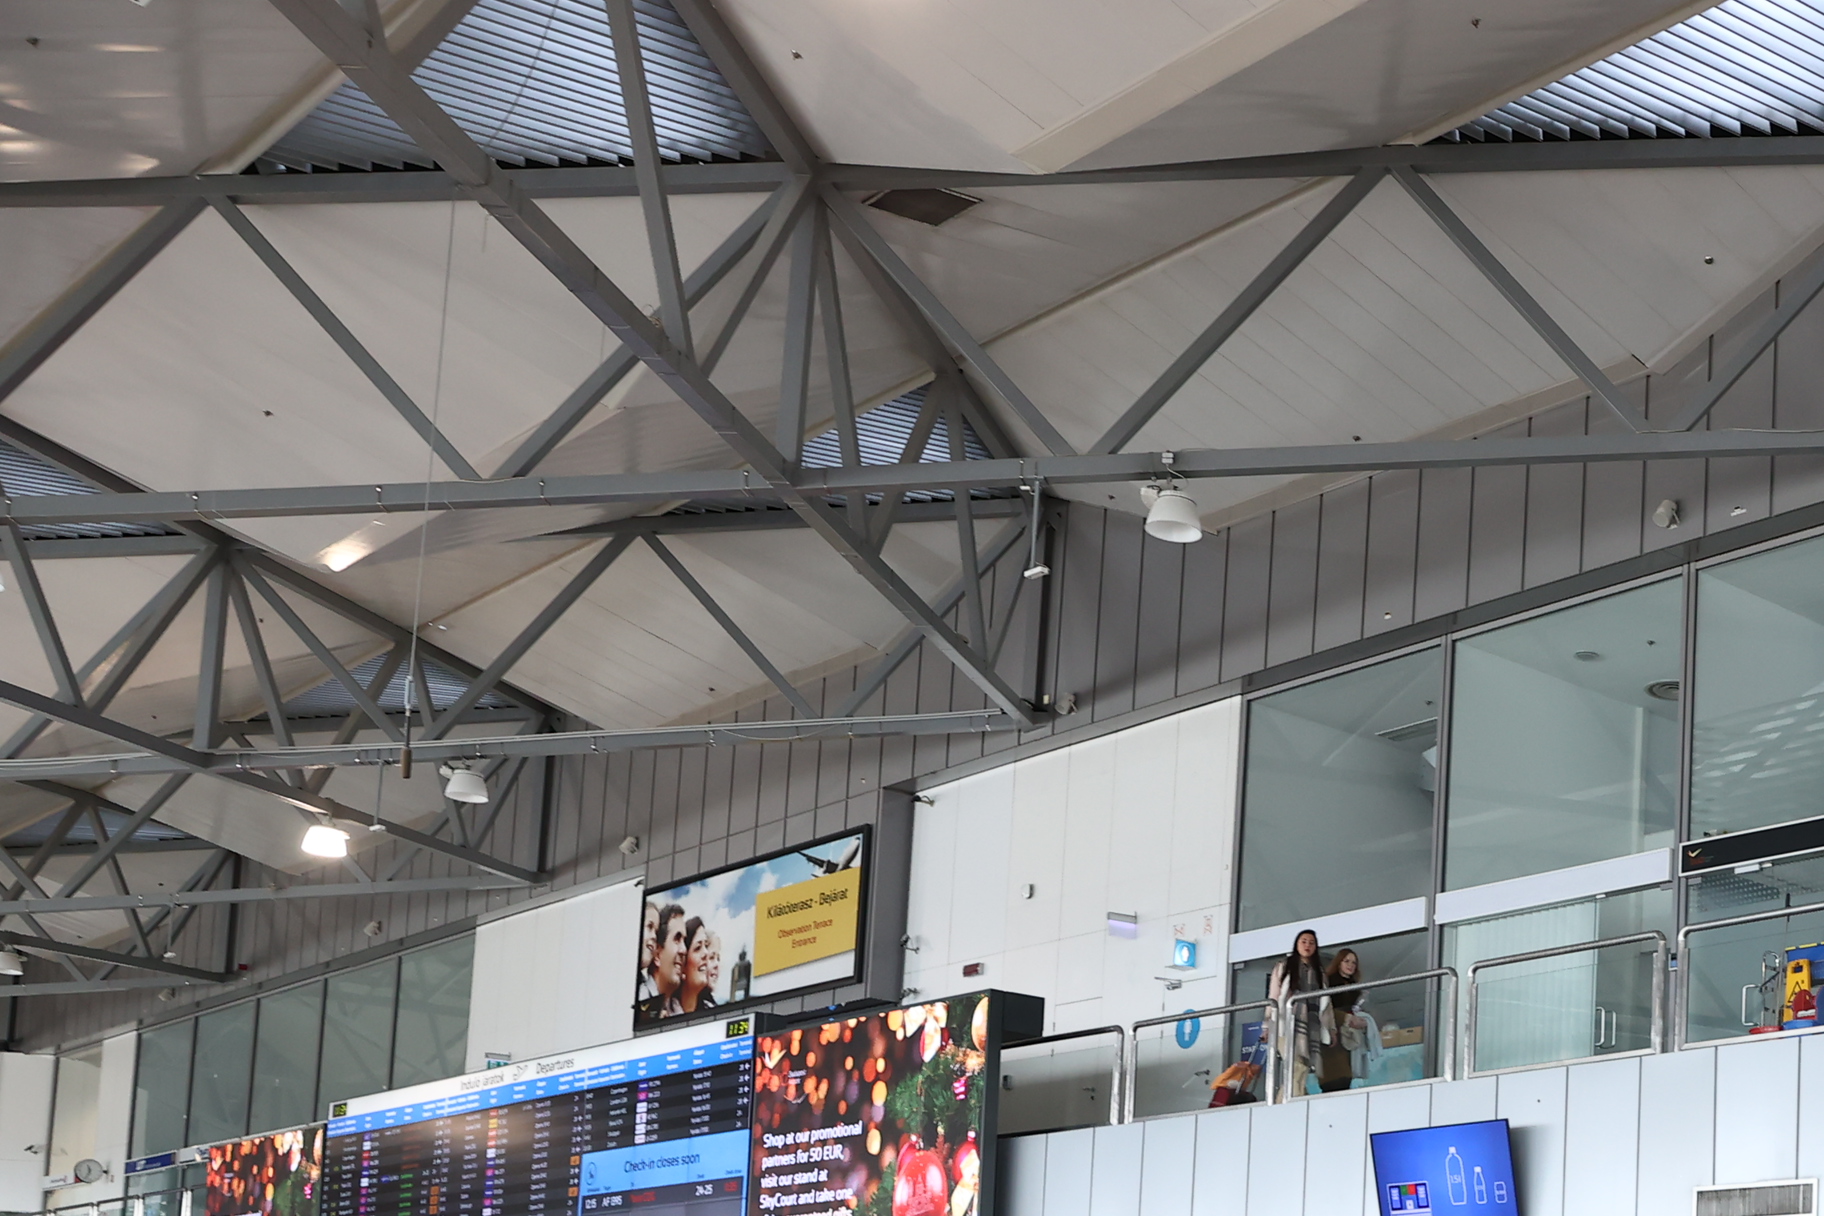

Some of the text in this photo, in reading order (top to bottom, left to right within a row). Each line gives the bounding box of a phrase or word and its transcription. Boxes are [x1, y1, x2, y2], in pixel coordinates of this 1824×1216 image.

[536, 1059, 574, 1075] Departures
[763, 1121, 863, 1149] Shop at our promotional
[624, 1153, 700, 1173] Check-in closes soon
[762, 1152, 795, 1171] partners
[797, 1150, 808, 1163] for
[809, 1148, 821, 1162] 50
[761, 1168, 828, 1189] visit our stand at
[760, 1188, 853, 1211] SkyCourt and take one
